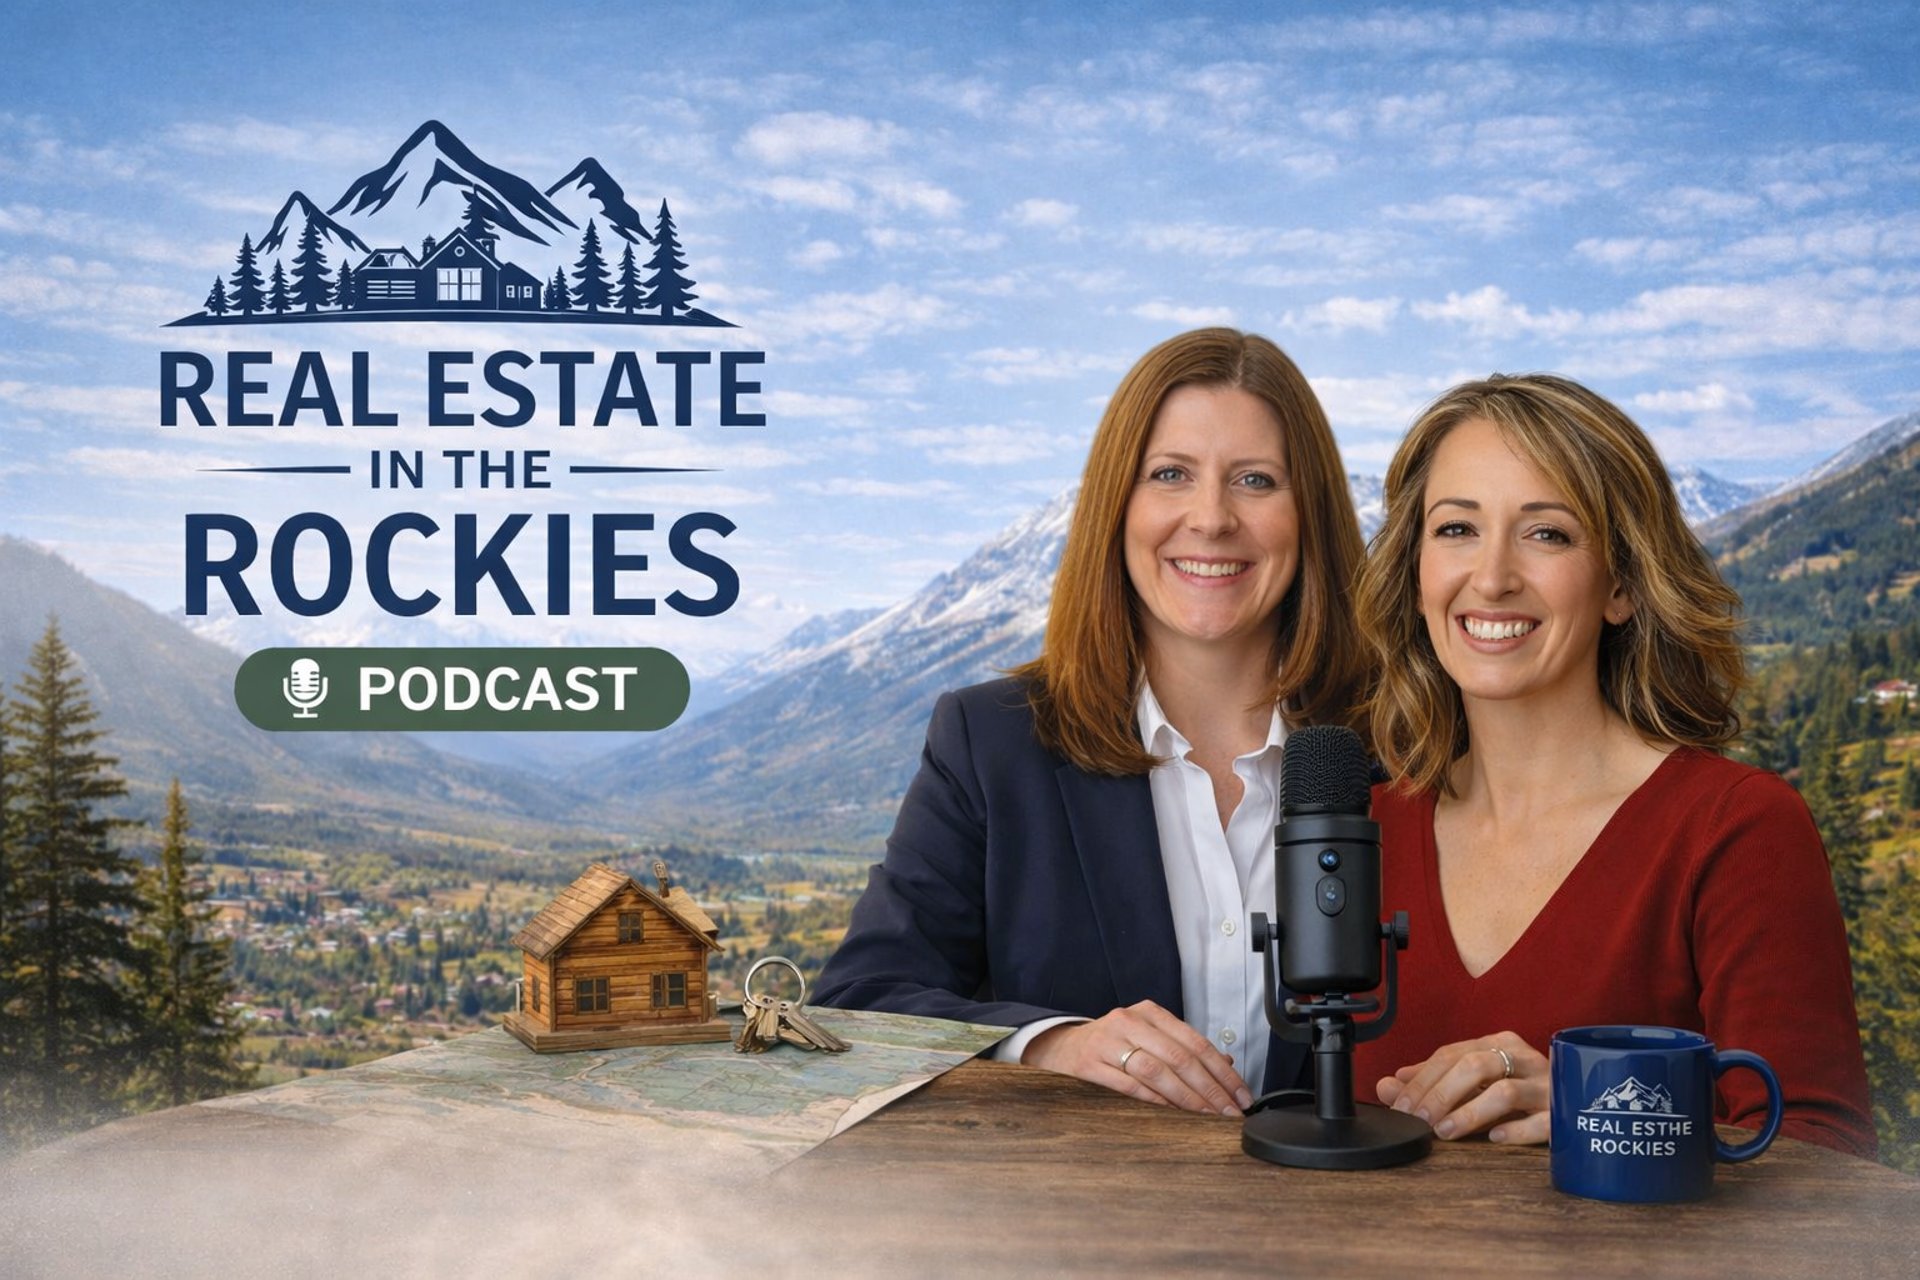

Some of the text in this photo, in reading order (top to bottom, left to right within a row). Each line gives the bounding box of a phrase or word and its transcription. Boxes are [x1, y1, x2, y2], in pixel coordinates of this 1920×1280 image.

[1577, 1116, 1692, 1136] REAL ESTHE
[1590, 1138, 1676, 1156] ROCKIES
